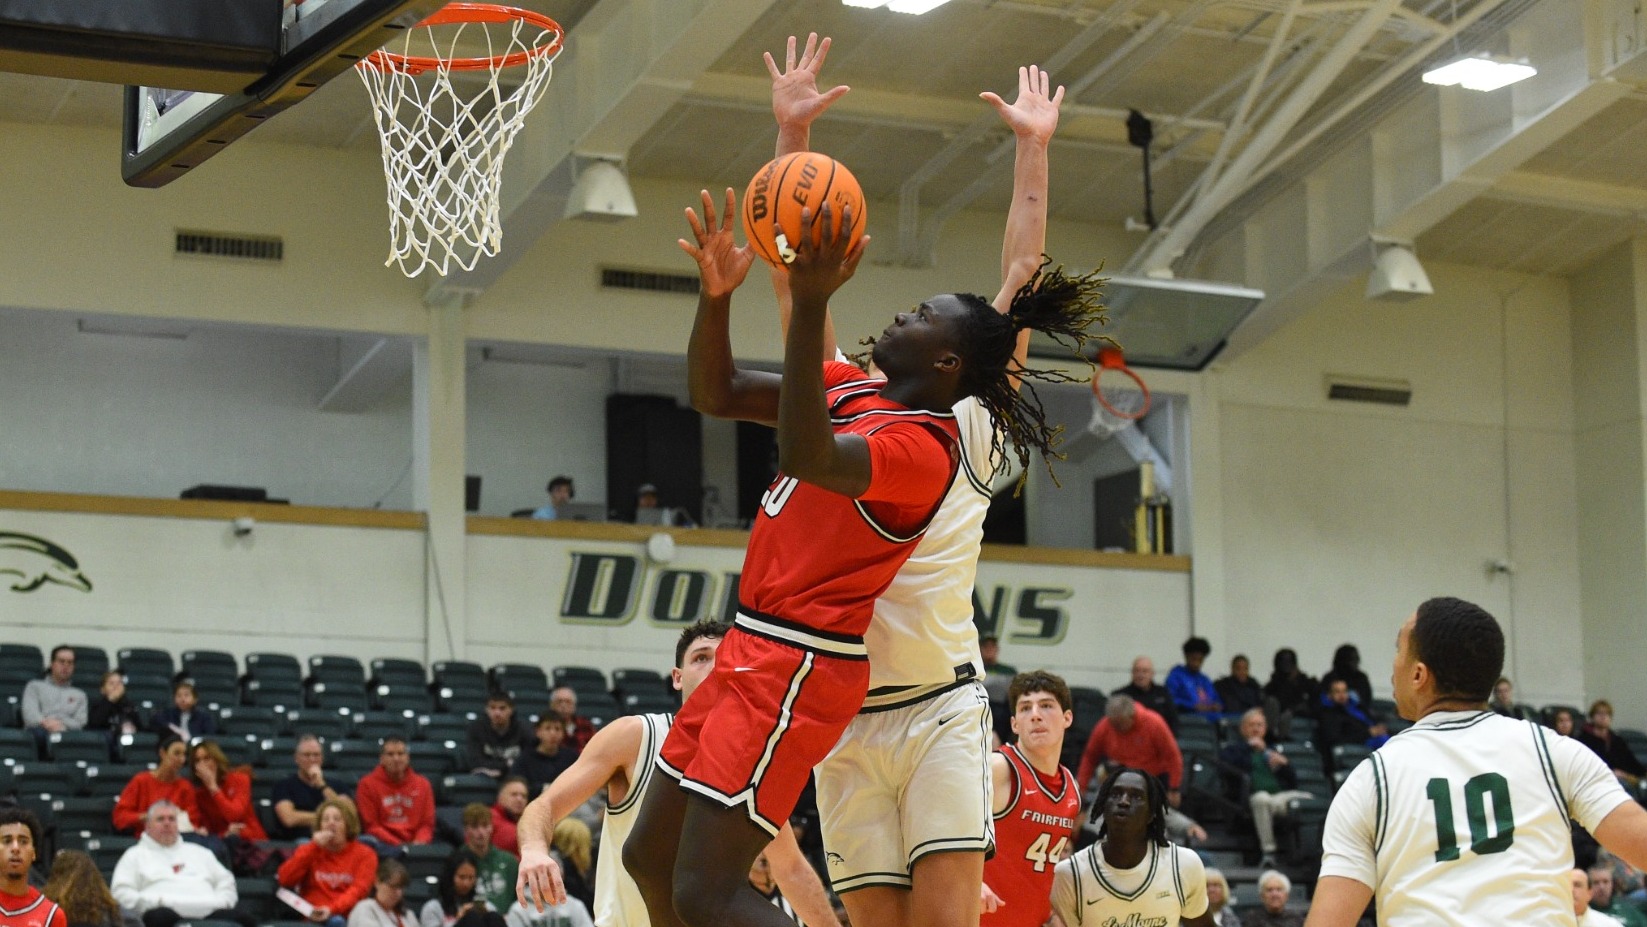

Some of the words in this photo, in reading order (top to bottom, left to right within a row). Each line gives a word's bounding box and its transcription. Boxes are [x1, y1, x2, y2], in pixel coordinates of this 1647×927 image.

[792, 163, 818, 206] EVO
[1021, 809, 1074, 829] FAIRFIEL
[1426, 772, 1515, 863] 10
